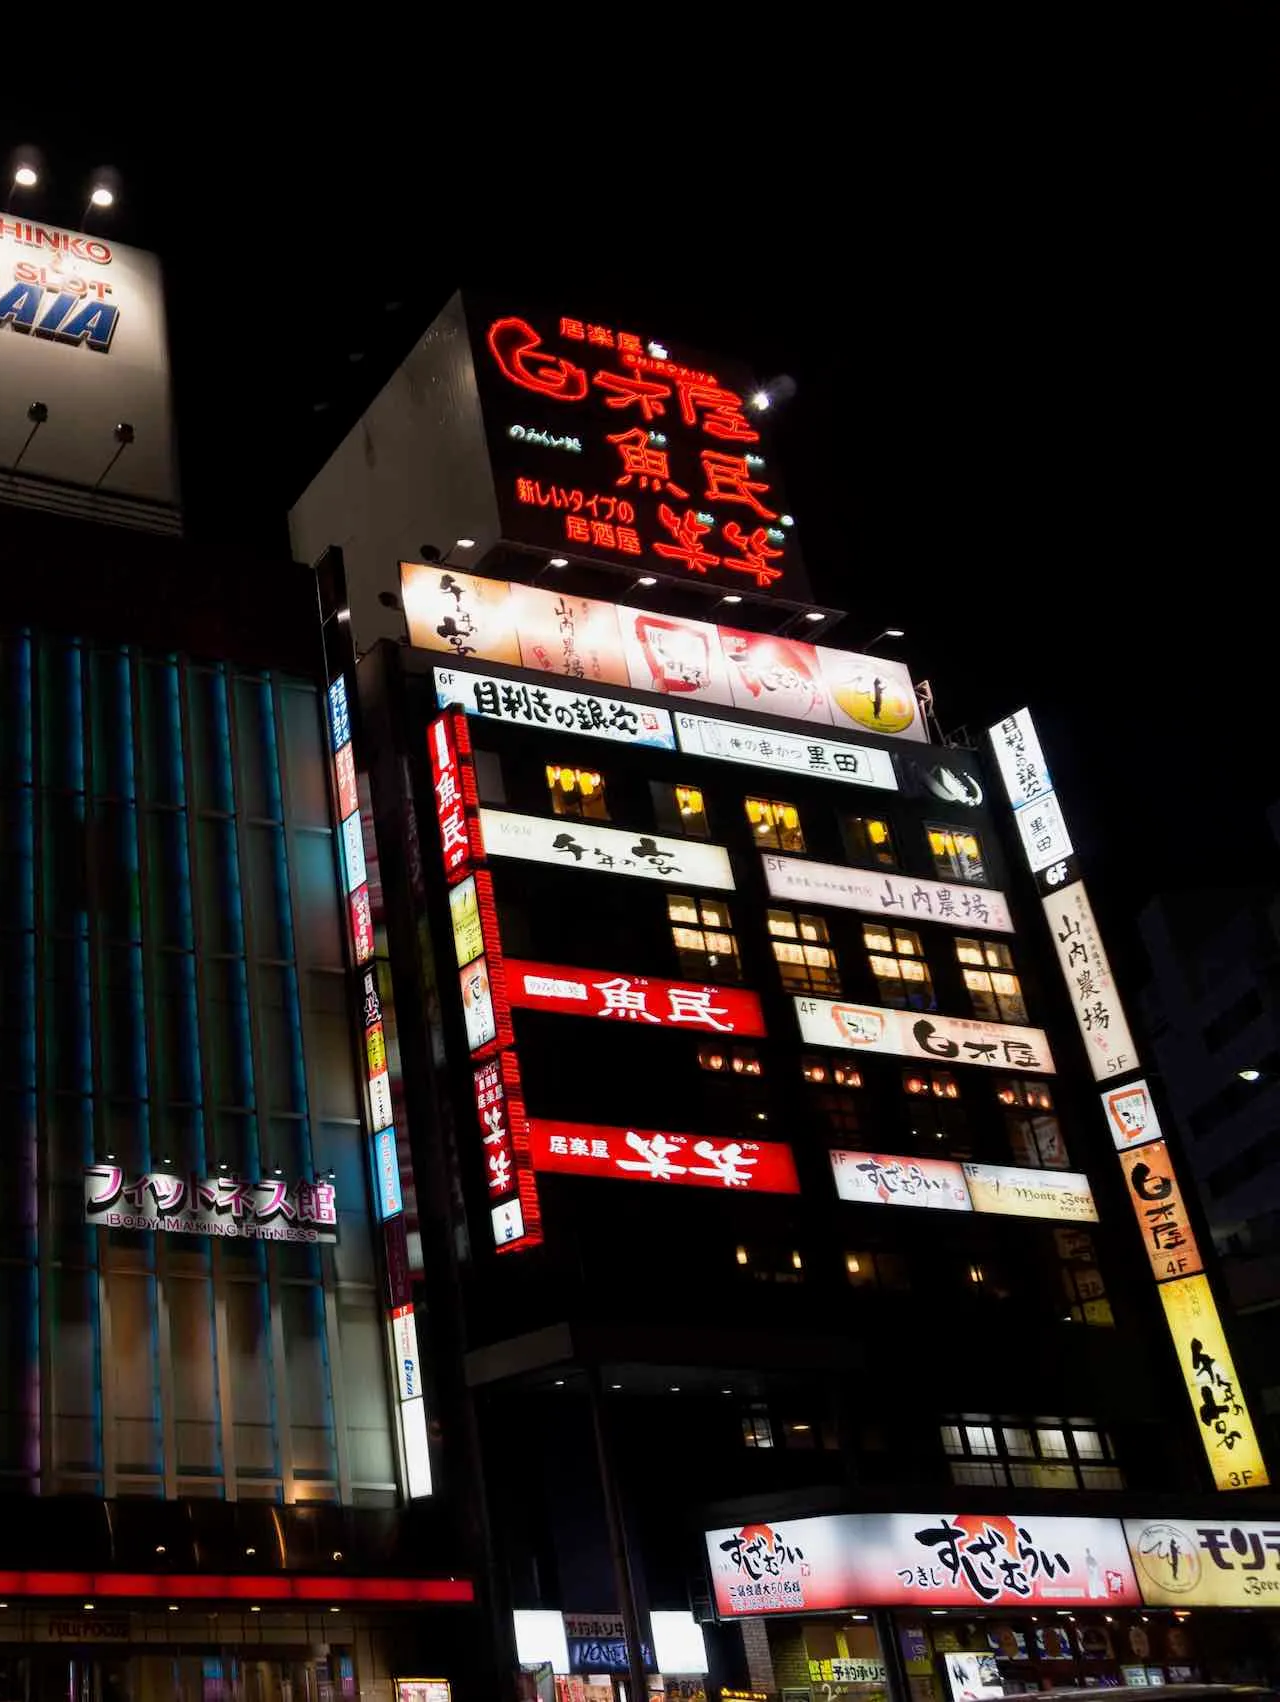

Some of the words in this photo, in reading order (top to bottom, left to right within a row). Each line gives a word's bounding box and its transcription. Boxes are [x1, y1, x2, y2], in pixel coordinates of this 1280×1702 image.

[559, 317, 643, 353] 居楽屋
[605, 428, 780, 521] 魚民
[516, 477, 635, 524] 新しいタイプの
[566, 515, 642, 555] 居酒屋
[438, 672, 456, 686] 6F
[473, 679, 640, 736] 目利きの銀次
[680, 716, 696, 730] 6F
[806, 743, 860, 774] 黒田
[434, 770, 469, 852] 魚民
[450, 849, 464, 867] 2F
[1045, 861, 1070, 886] 6F
[766, 857, 787, 873] 5F
[880, 879, 991, 925] 山内農場
[1056, 912, 1111, 1033] 山内農場
[591, 977, 735, 1032] 魚民
[799, 1001, 818, 1016] 4F
[911, 1018, 1041, 1068] 白木屋
[1105, 1054, 1129, 1075] 5F
[548, 1135, 611, 1159] 居楽屋
[84, 1163, 337, 1226] フィットネス館
[1014, 1186, 1058, 1203] Monte
[1130, 1162, 1188, 1251] 白木屋
[106, 1211, 160, 1231] BODY
[163, 1214, 239, 1237] MAKING
[244, 1222, 319, 1242] FITNESS
[1166, 1258, 1189, 1276] 4F
[1229, 1469, 1254, 1490] 3F
[896, 1565, 943, 1587] つきじ
